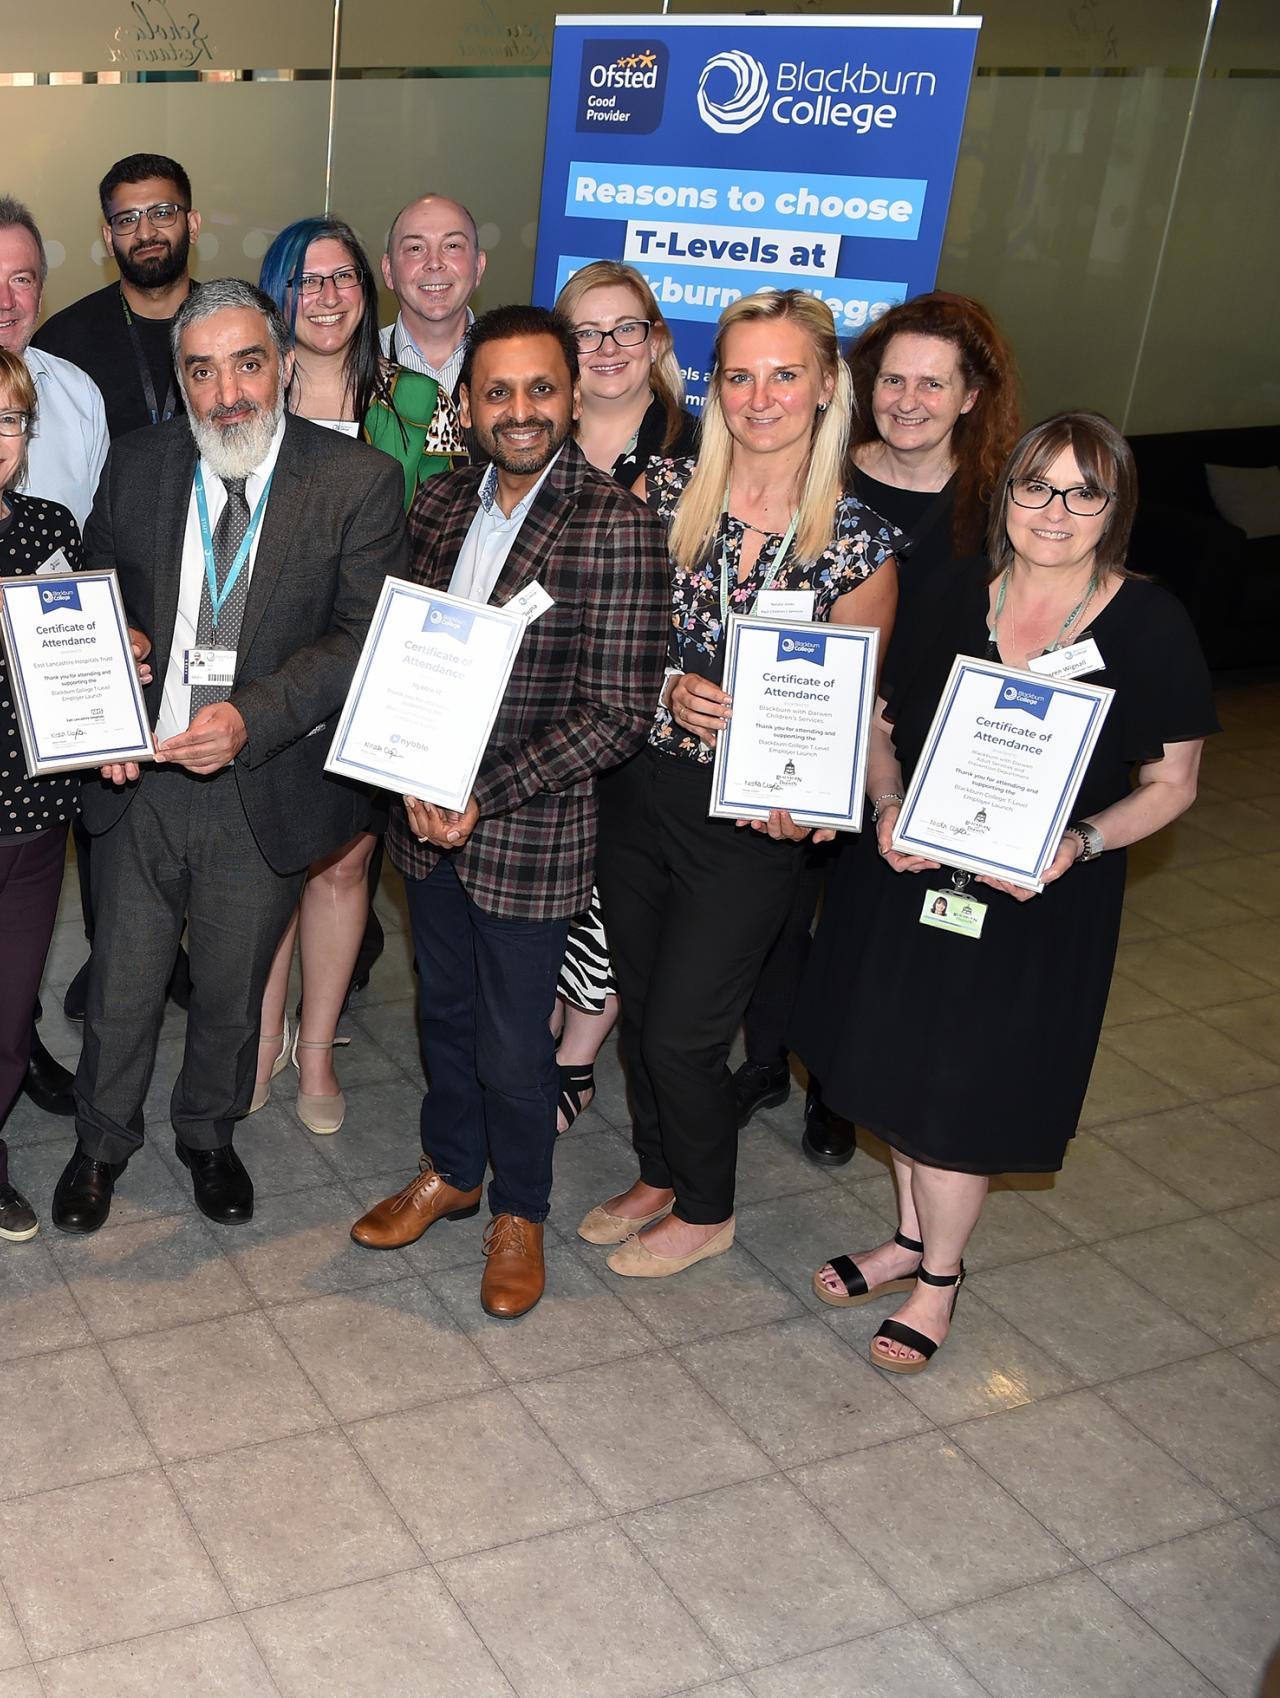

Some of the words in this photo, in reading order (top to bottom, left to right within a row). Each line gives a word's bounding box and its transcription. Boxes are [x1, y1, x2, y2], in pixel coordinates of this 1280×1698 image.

[589, 63, 658, 90] Ofsted
[776, 62, 937, 96] Blackburn
[588, 95, 616, 109] Good
[586, 109, 631, 122] Provider
[772, 97, 897, 134] College
[575, 176, 718, 210] Reasons
[727, 185, 764, 213] to
[775, 188, 913, 223] choose
[635, 230, 780, 264] T-Levels
[789, 241, 827, 269] at
[234, 551, 245, 569] STAFF
[36, 624, 84, 635] Certificate
[87, 621, 95, 630] of
[42, 637, 96, 648] Attendance
[794, 645, 815, 653] College
[404, 640, 459, 663] Certificate
[402, 655, 465, 679] Attendance
[762, 673, 820, 686] Certificate
[823, 679, 835, 688] of
[764, 687, 830, 702] Attendance
[1016, 695, 1039, 705] College
[759, 705, 791, 713] Blackburn
[798, 716, 823, 724] Services
[773, 733, 804, 741] supporting
[795, 728, 823, 736] attending
[976, 717, 1036, 738] Certificate
[1039, 734, 1052, 742] of
[974, 731, 1043, 755] Attendance
[956, 768, 973, 776] Thank
[996, 780, 1025, 792] attending
[972, 781, 1004, 793] supporting
[991, 802, 1013, 812] Launch
